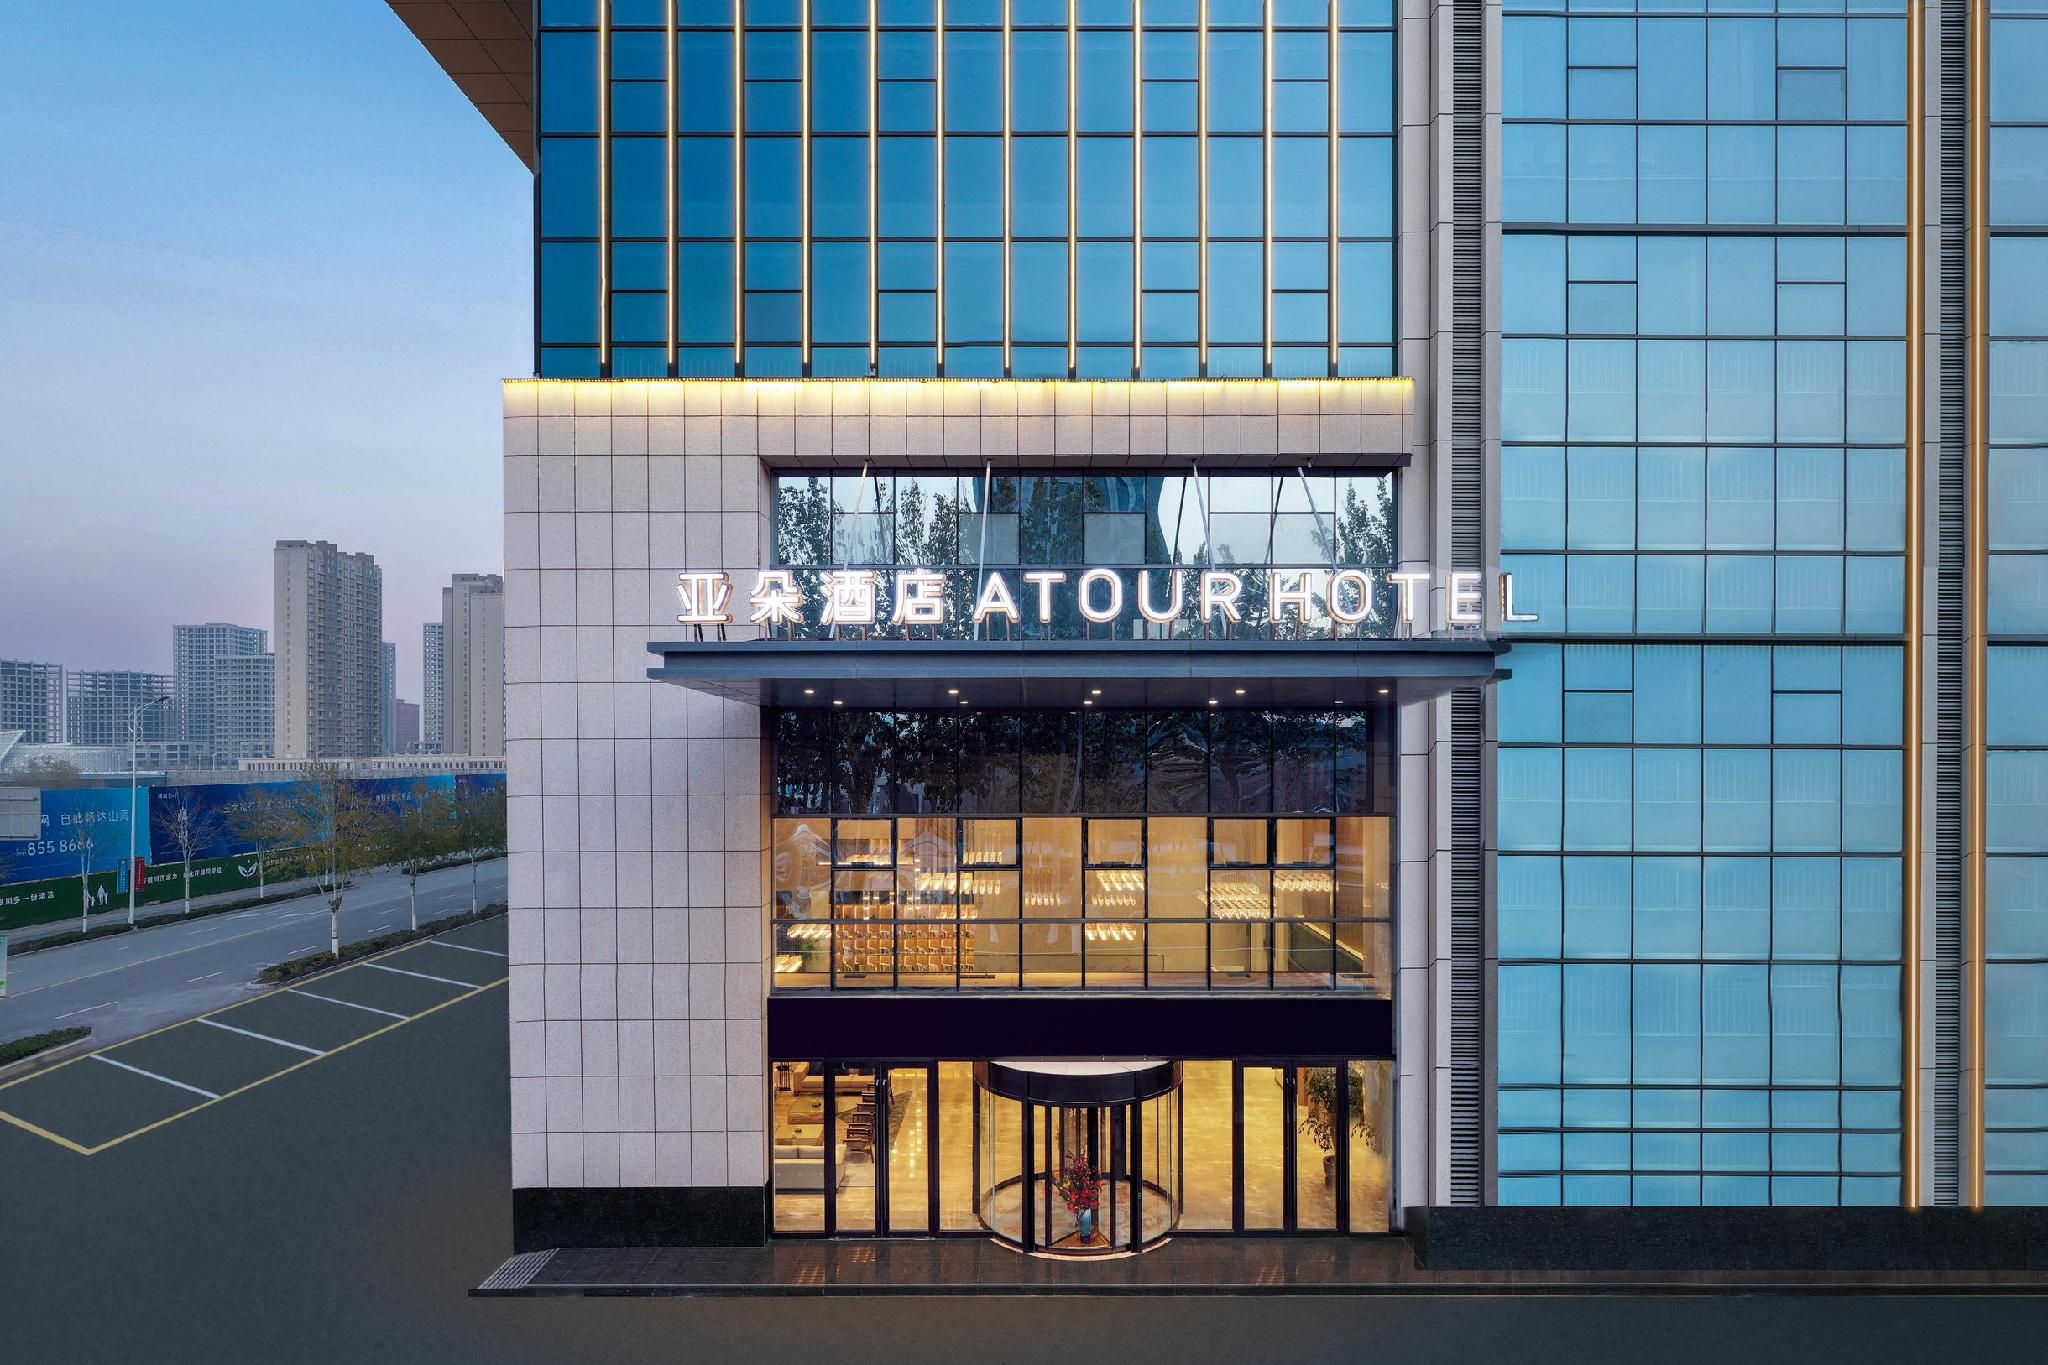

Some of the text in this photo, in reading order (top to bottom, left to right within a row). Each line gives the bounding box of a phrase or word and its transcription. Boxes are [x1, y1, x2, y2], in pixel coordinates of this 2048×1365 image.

[676, 568, 947, 625] 亚朵酒店
[972, 568, 1539, 624] ATOUR HOTEL
[27, 840, 55, 856] 855
